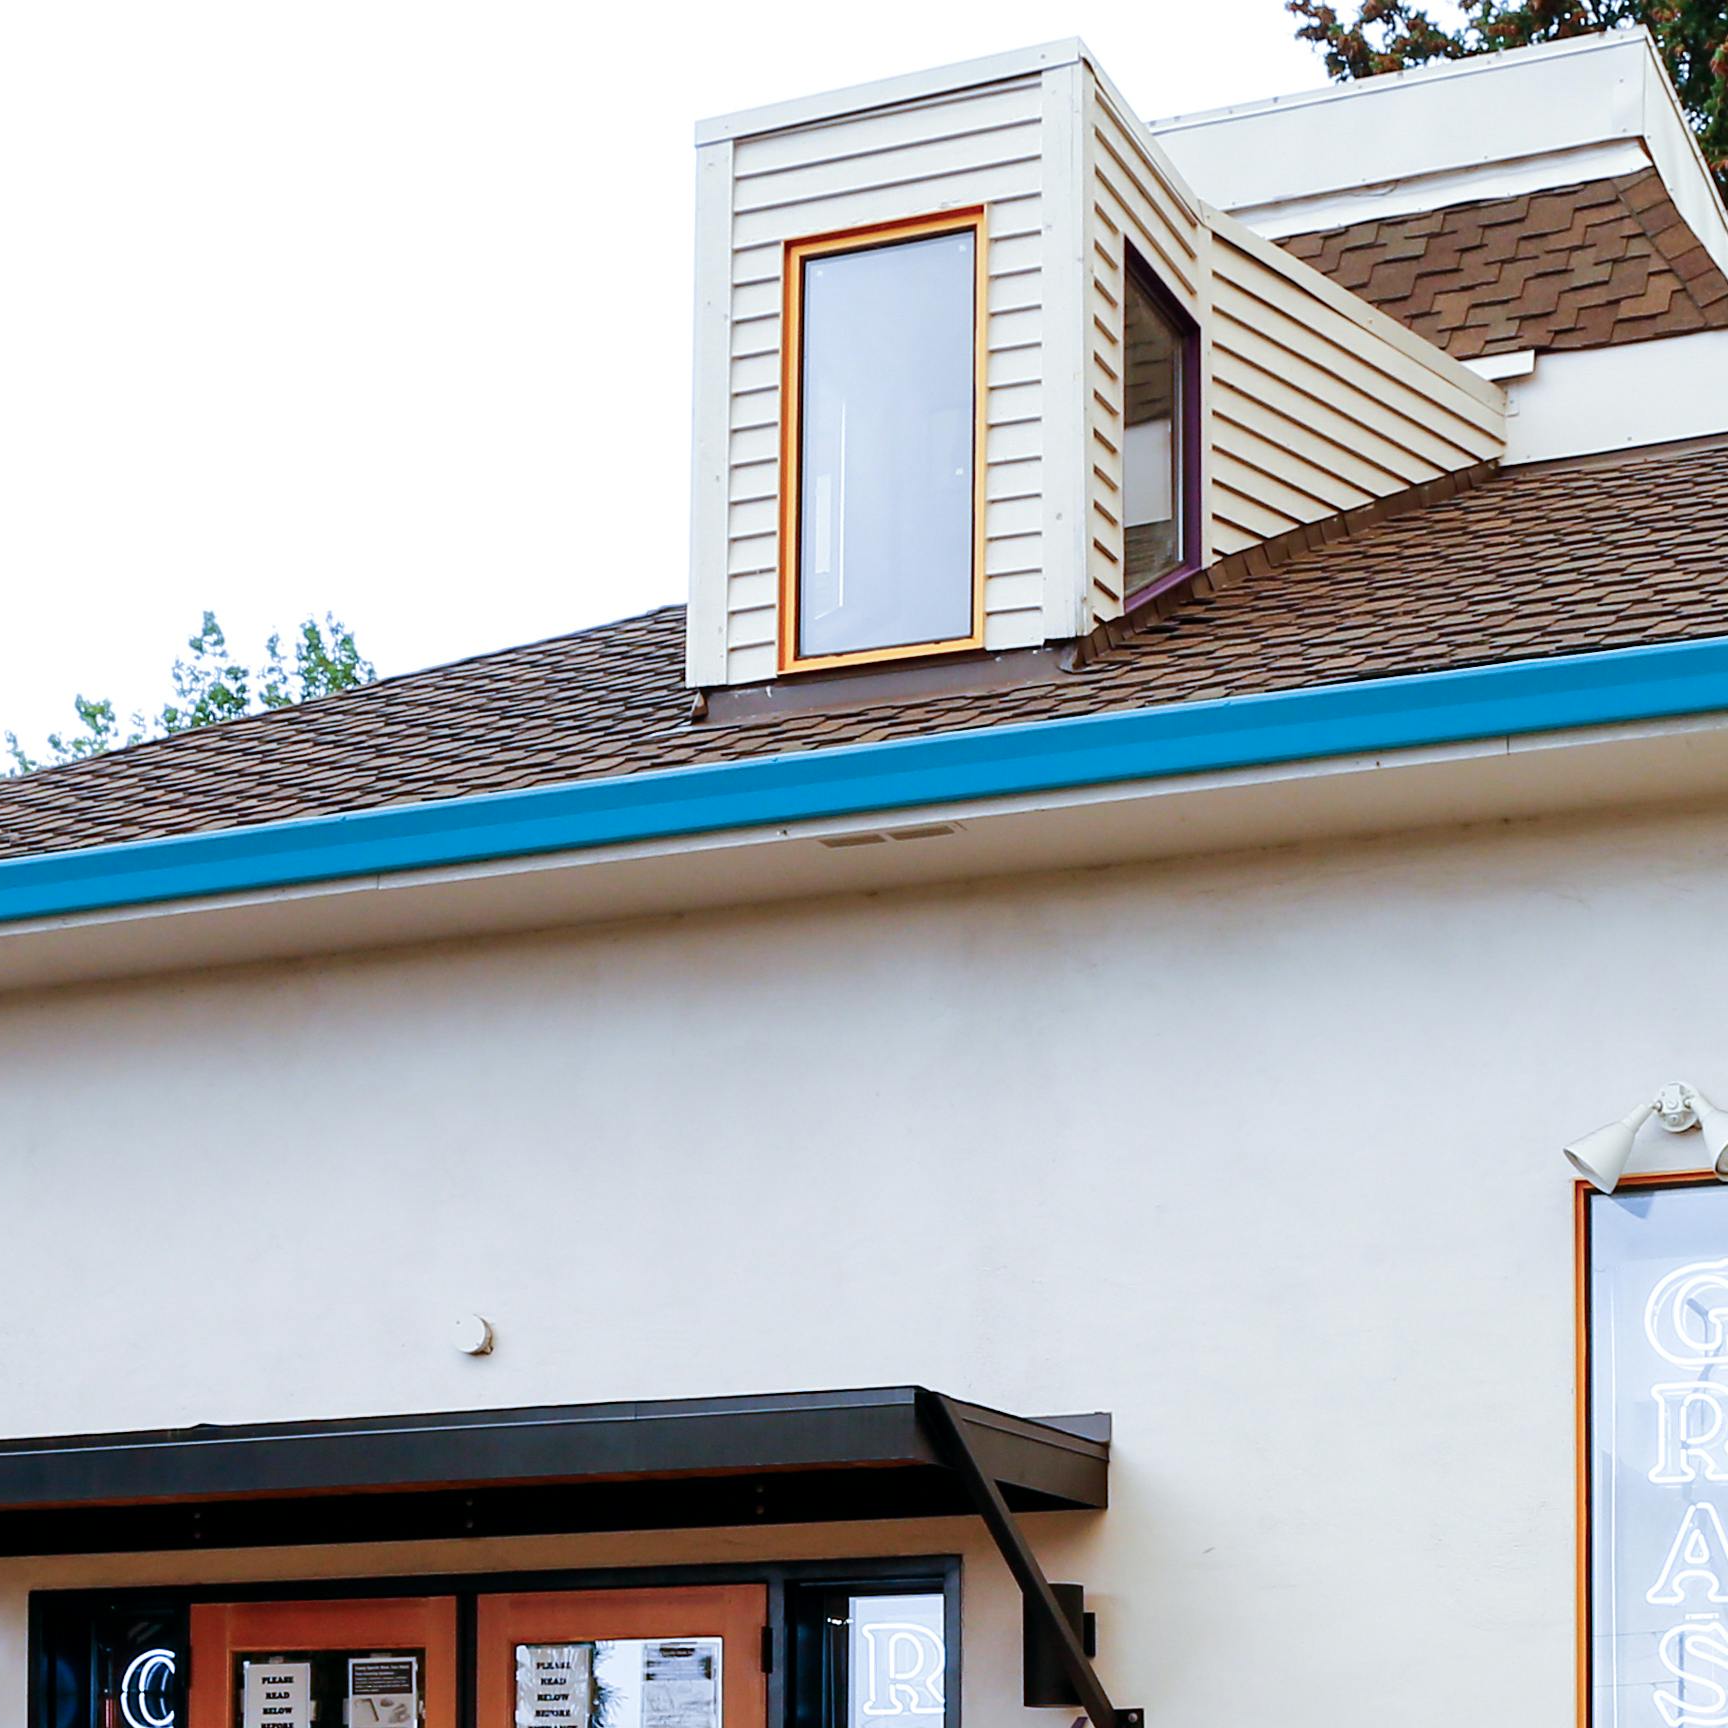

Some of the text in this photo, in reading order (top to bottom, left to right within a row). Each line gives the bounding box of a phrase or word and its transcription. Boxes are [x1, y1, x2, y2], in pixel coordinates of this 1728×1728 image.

[261, 1676, 294, 1684] PLEASE
[540, 1678, 567, 1686] READ
[265, 1691, 290, 1699] READ
[537, 1693, 569, 1702] BELOW
[262, 1707, 293, 1715] BELOW
